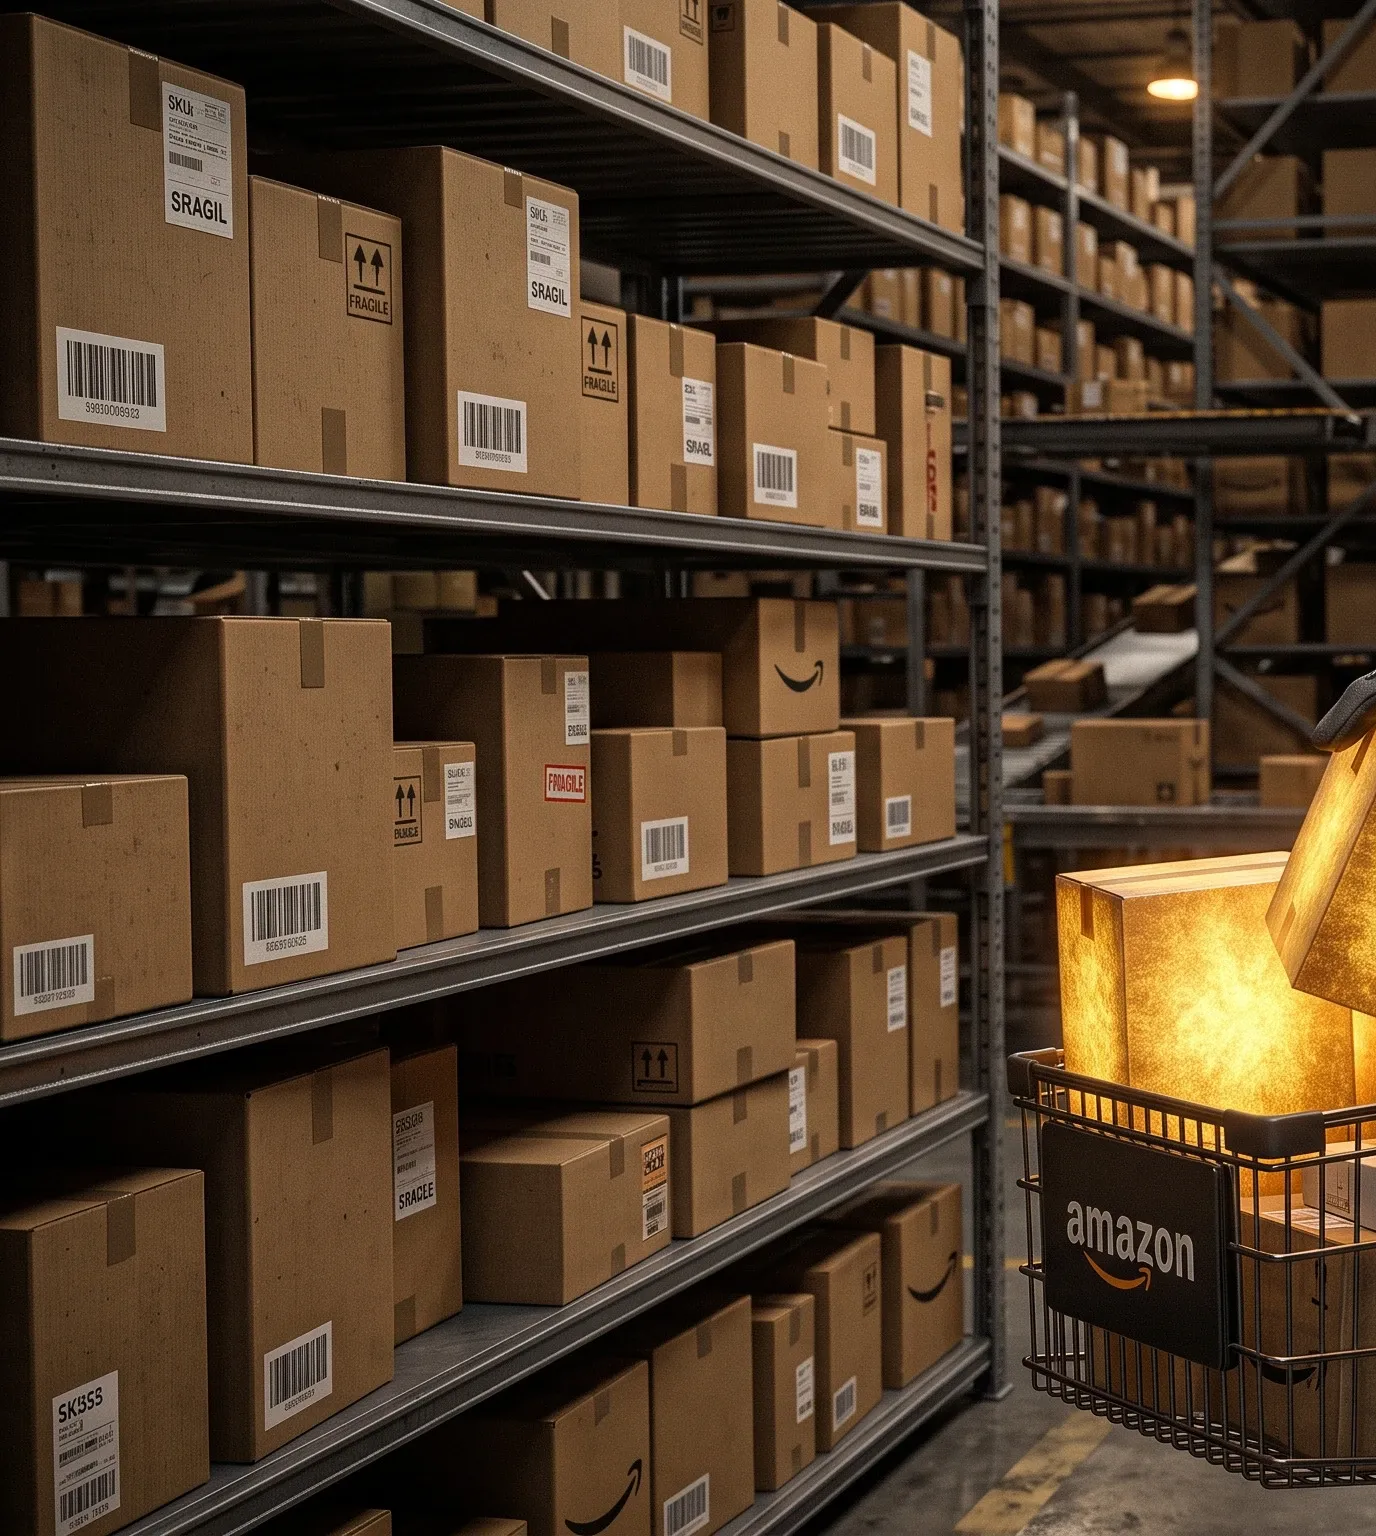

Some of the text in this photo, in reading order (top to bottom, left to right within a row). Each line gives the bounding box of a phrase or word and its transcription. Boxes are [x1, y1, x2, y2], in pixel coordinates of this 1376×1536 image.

[171, 190, 228, 225] SRAGIL
[349, 294, 389, 316] FRAGILE
[531, 281, 568, 307] SRAGIL
[1066, 1200, 1195, 1282] amazon
